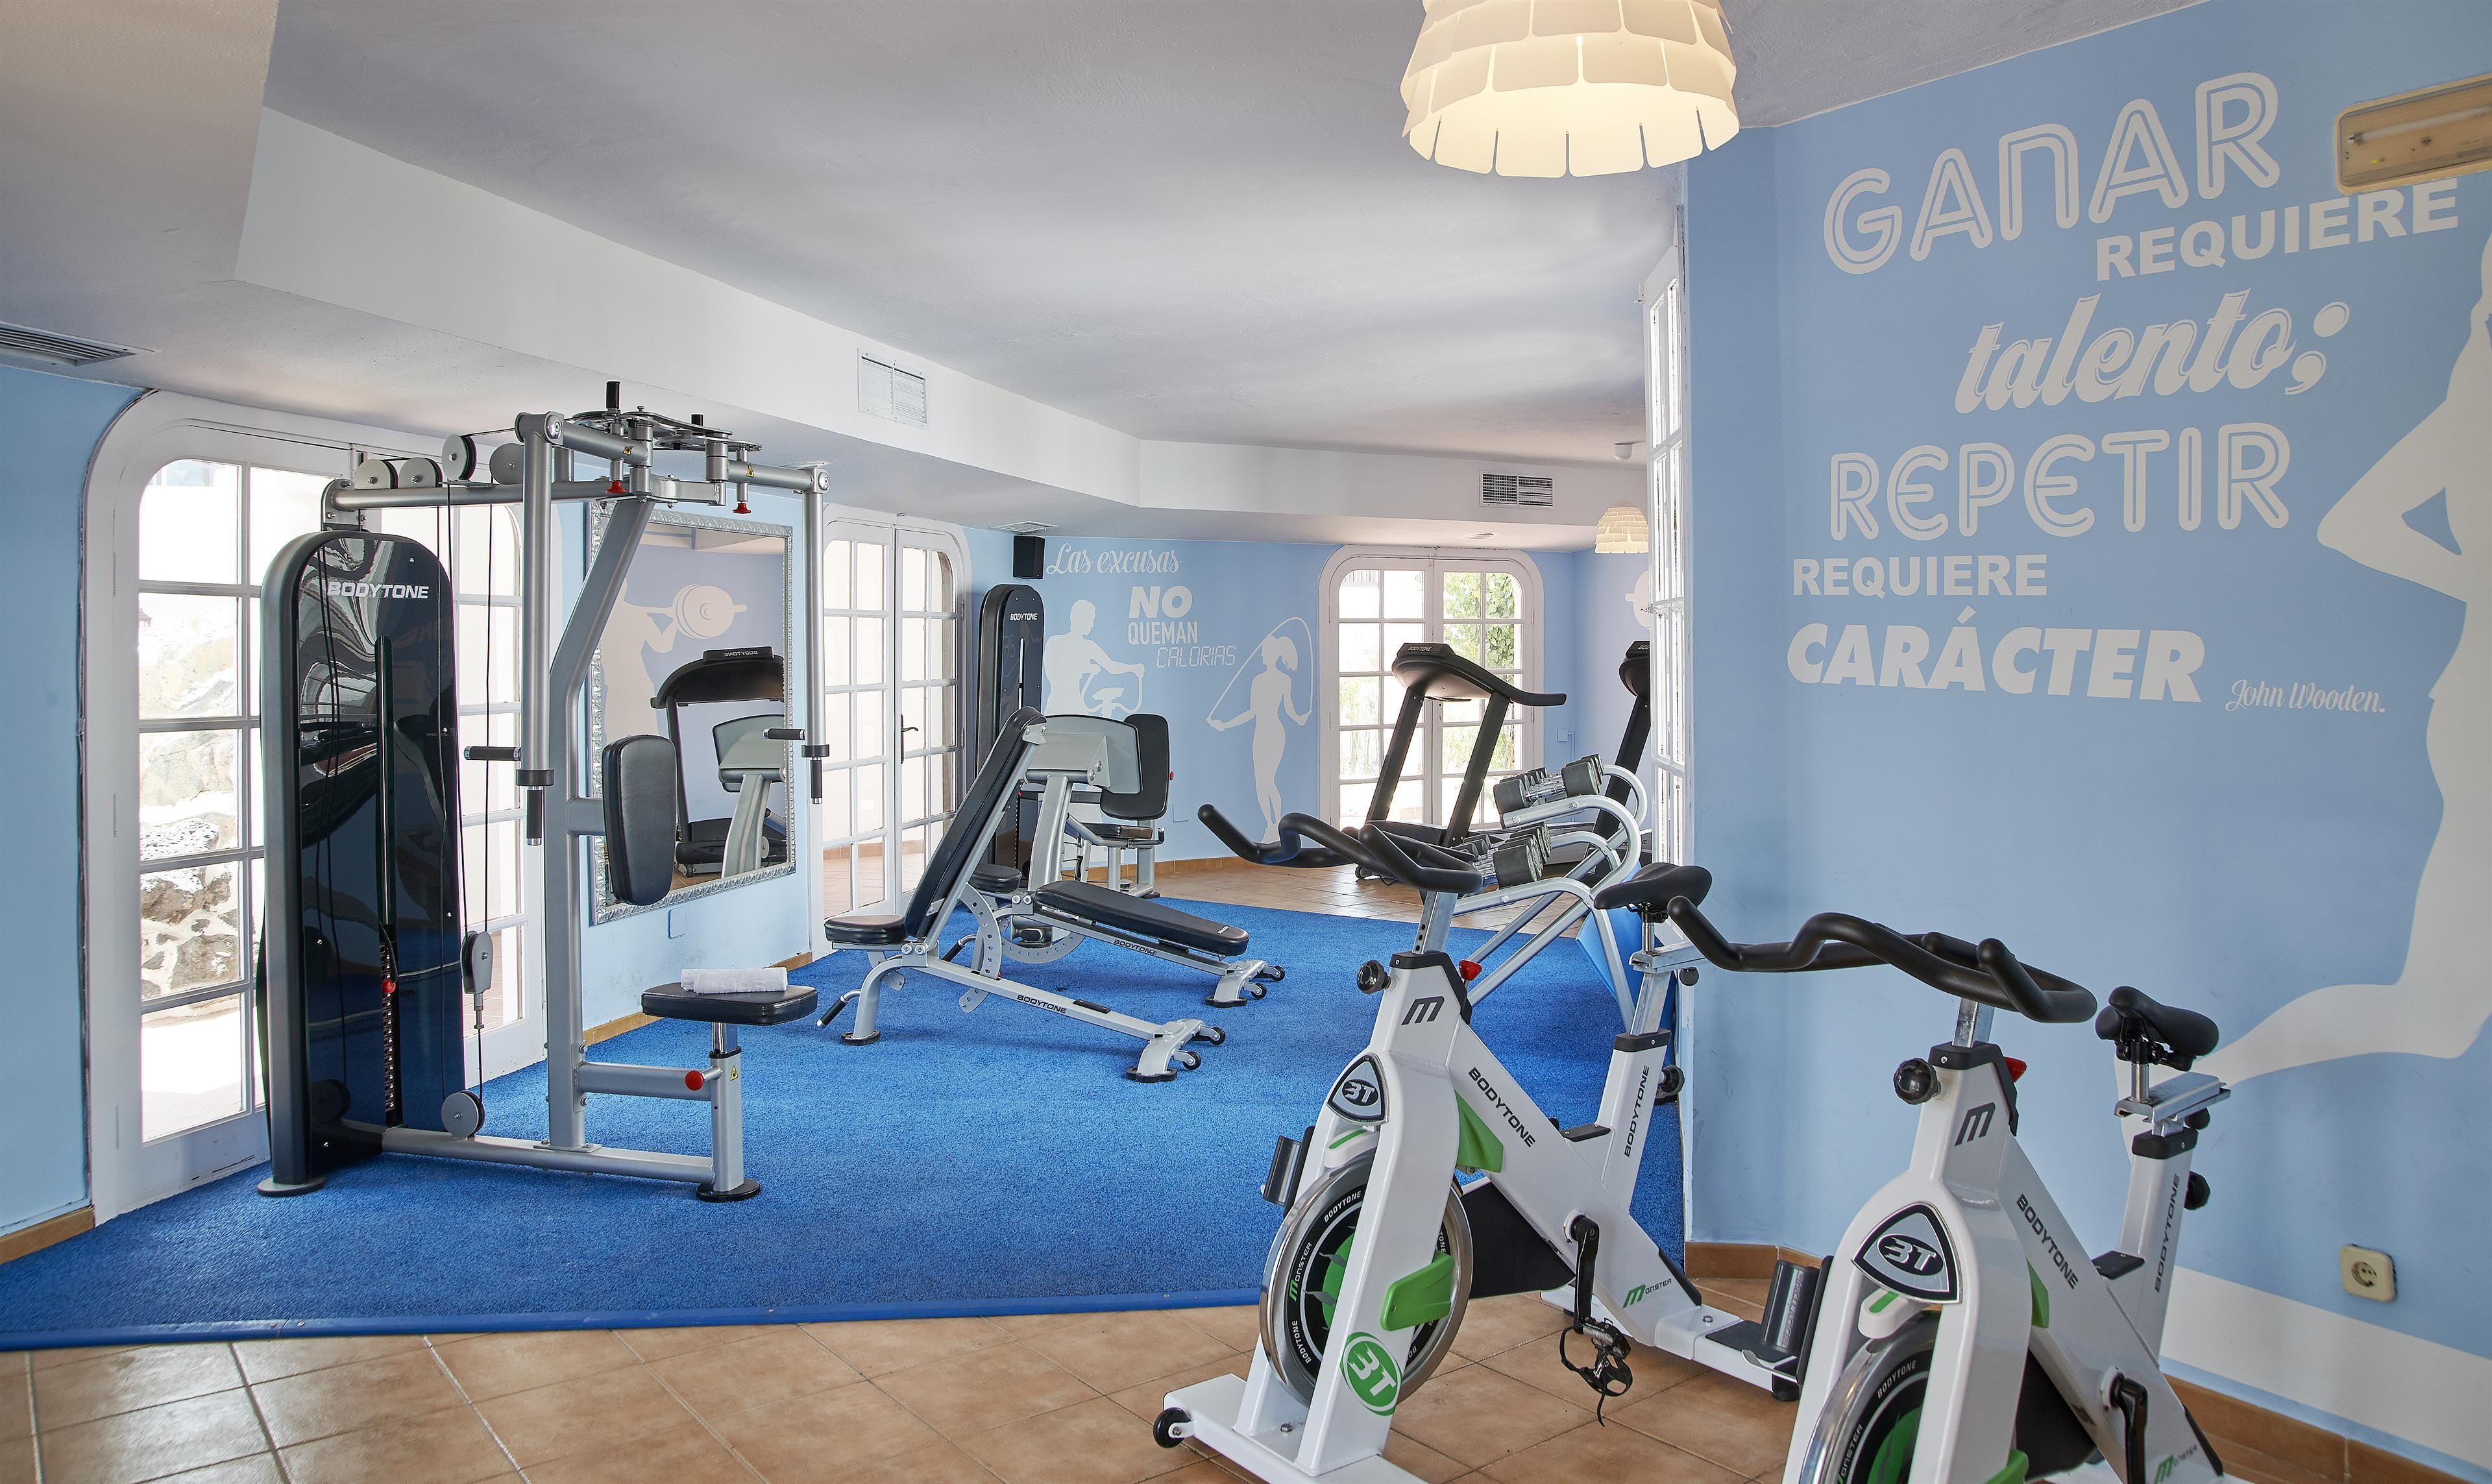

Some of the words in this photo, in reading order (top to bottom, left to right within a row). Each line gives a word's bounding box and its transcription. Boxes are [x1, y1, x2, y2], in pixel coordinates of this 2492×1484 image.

[1824, 72, 2280, 274] GANAR
[2097, 178, 2460, 282] REQUIERE
[1955, 288, 2350, 413] talento;
[1829, 423, 2291, 541] REPETIR
[1046, 543, 1094, 574] Las
[1097, 549, 1182, 574] excusas
[1793, 555, 2047, 599] REQUIERE
[327, 581, 430, 599] BODYTONE
[1129, 586, 1193, 618] NO
[1010, 613, 1038, 621] BODYTONE
[1128, 621, 1198, 645] QUEMAN
[1156, 645, 1236, 668] CALORIAS
[1787, 605, 2206, 703] CARÁCTER
[2225, 679, 2285, 712] John
[2288, 681, 2386, 713] Wooden.
[1017, 994, 1067, 1014] BODYTONE
[1467, 1067, 1536, 1148] BODYTONE
[1624, 1065, 1650, 1158] BODYTONE
[1324, 1191, 1362, 1222] BODYTONE
[2016, 1193, 2078, 1291] BODYTONE
[2154, 1173, 2180, 1293] BODYTONE
[1291, 1320, 1311, 1365] BODYTONE
[1877, 1359, 1917, 1399] BODYTONE
[1837, 1423, 1864, 1484] ONSTER
